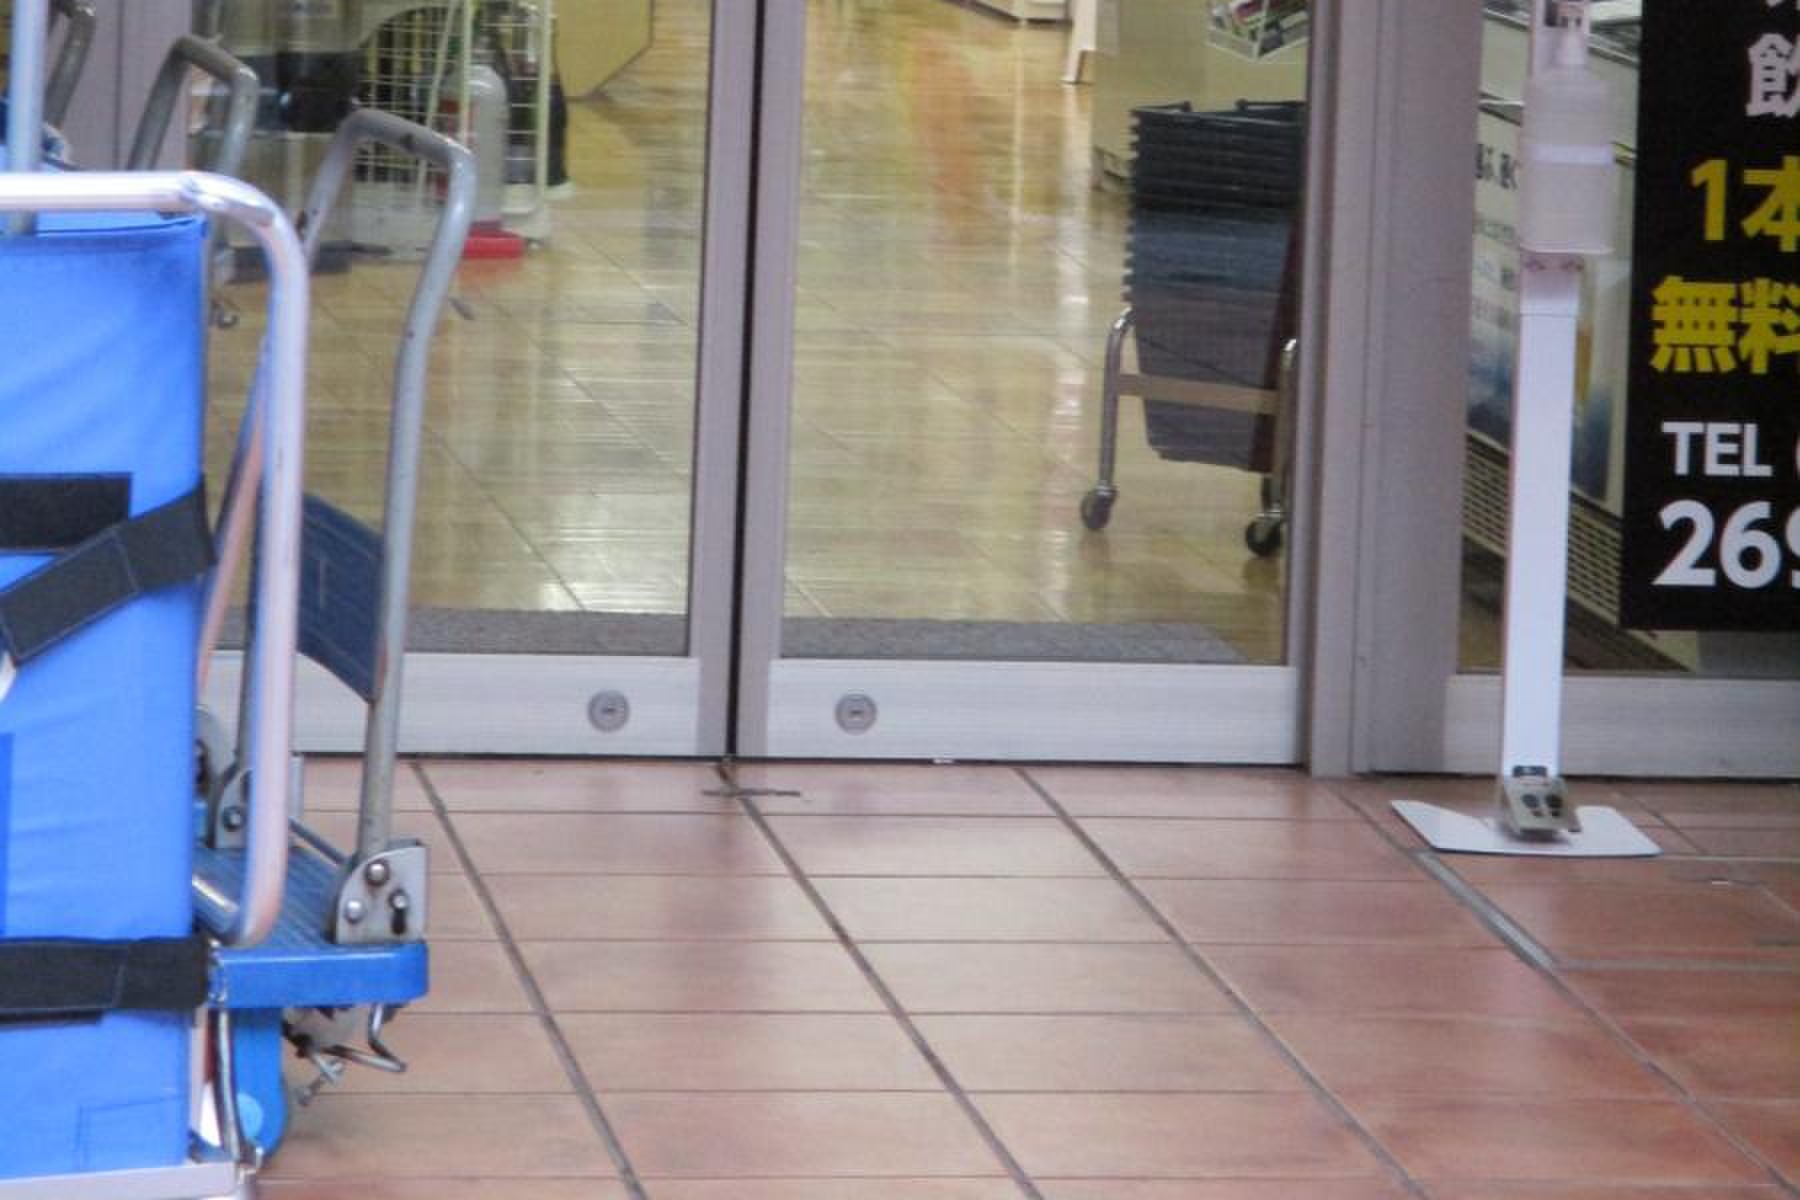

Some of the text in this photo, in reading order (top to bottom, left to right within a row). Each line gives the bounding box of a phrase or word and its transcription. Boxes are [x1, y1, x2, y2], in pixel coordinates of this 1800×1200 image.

[1650, 275, 1800, 374] 無料
[1661, 421, 1774, 478] TEL
[1651, 499, 1800, 590] 26
